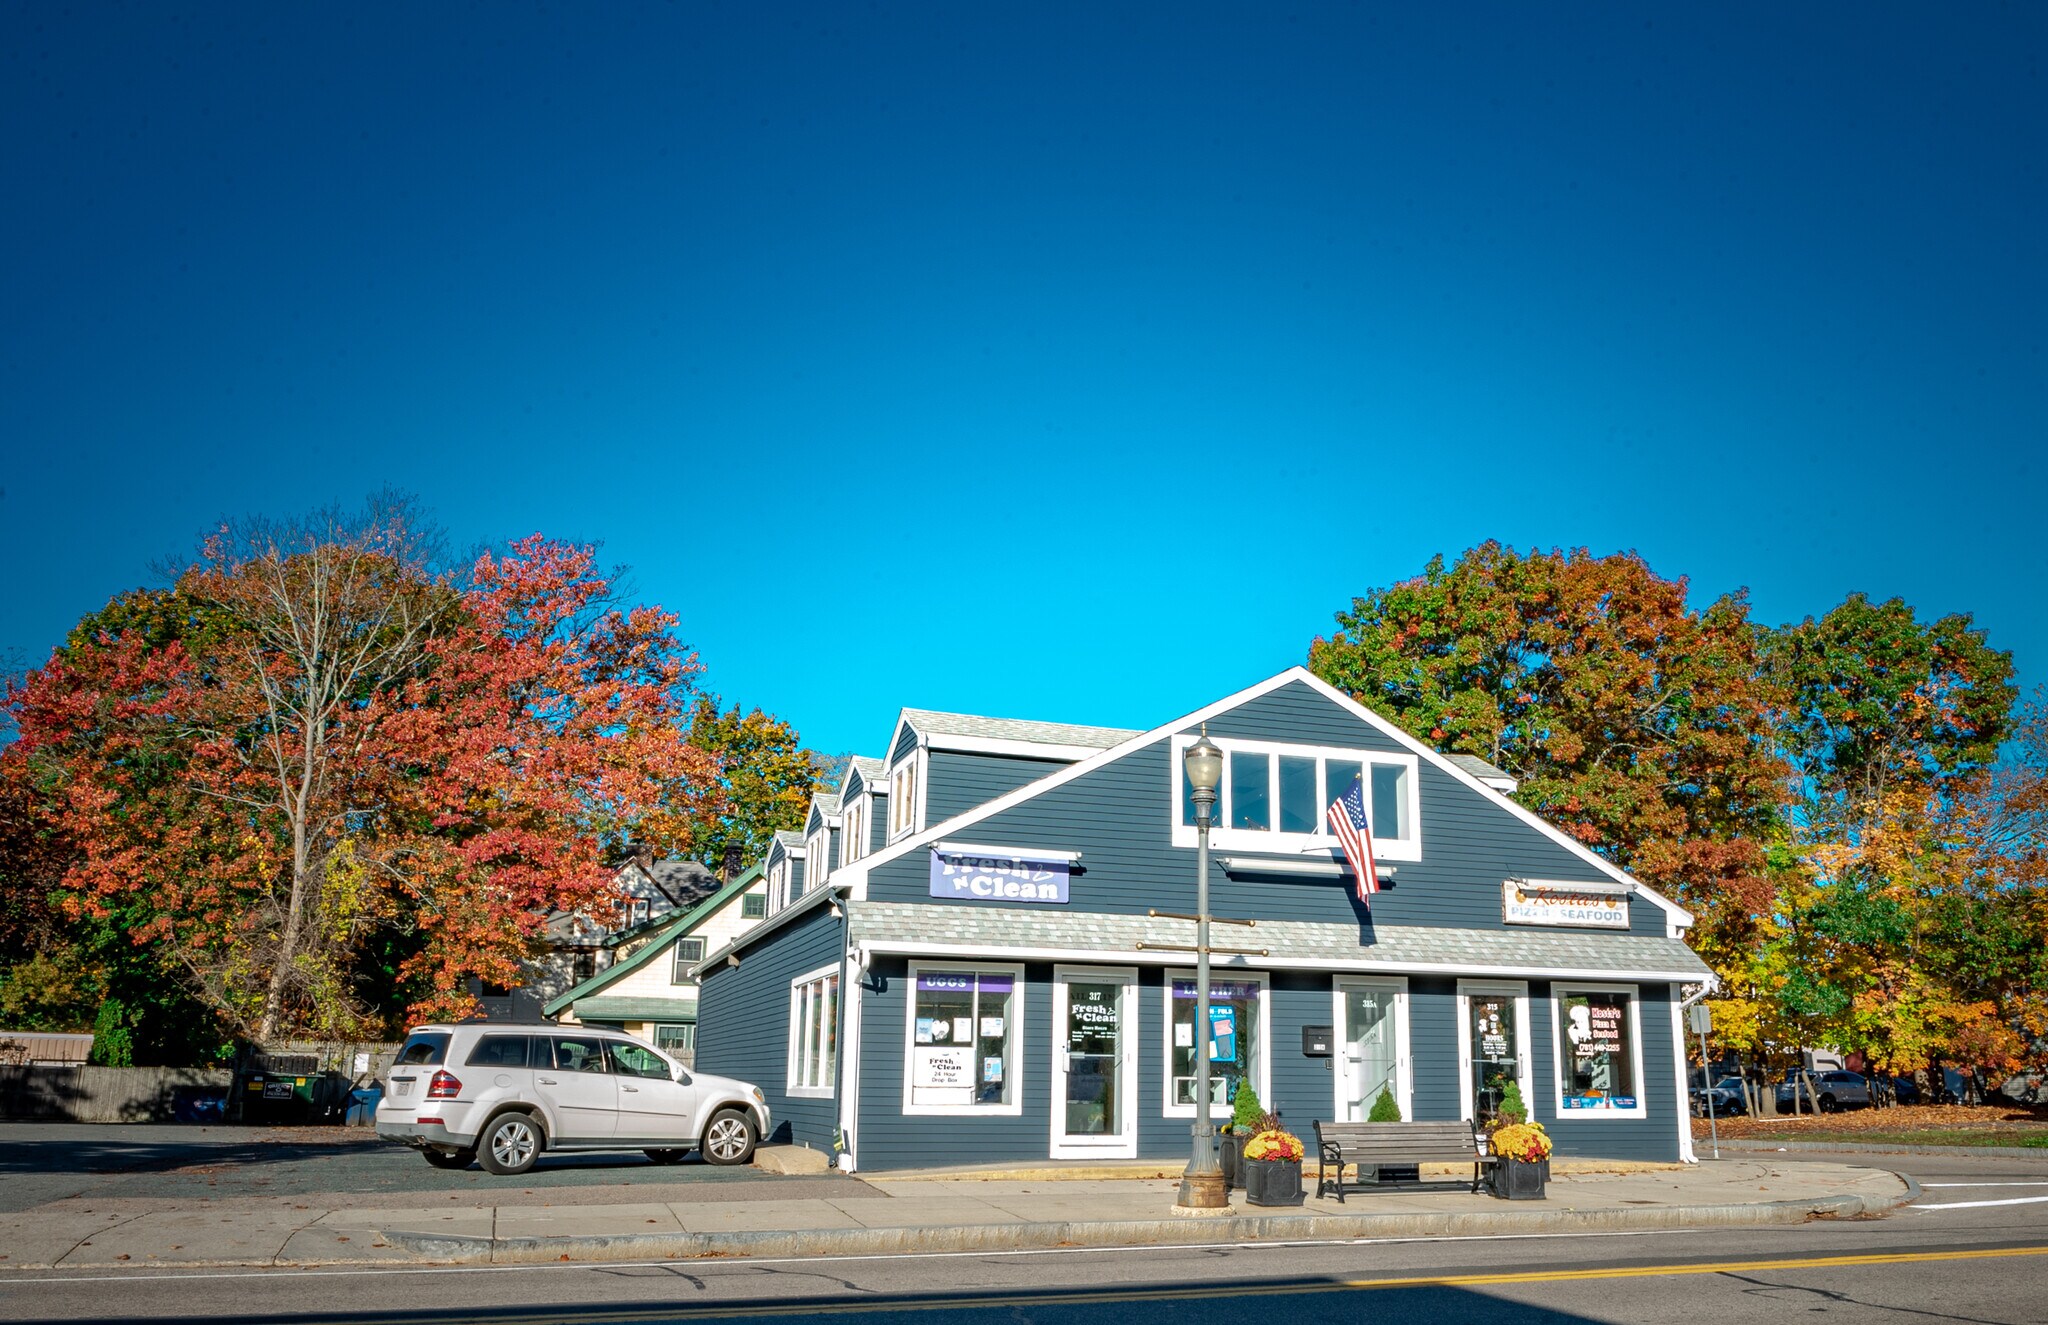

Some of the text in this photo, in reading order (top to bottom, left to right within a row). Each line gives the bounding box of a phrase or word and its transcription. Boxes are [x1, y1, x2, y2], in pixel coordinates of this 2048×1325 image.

[942, 853, 1030, 880] Fresh
[969, 875, 1058, 900] Clean
[1533, 886, 1600, 907] Kosta's
[1560, 908, 1623, 922] SEAFOOD
[926, 976, 967, 988] UGGS
[1088, 991, 1102, 1001] 317
[1183, 984, 1246, 996] LETHER
[1071, 1003, 1107, 1015] Fresh
[1486, 1003, 1498, 1011] 315
[1591, 1007, 1621, 1019] Kosta's
[1082, 1012, 1118, 1023] Clean
[1592, 1029, 1619, 1039] Seafood
[936, 1063, 962, 1071] Clean
